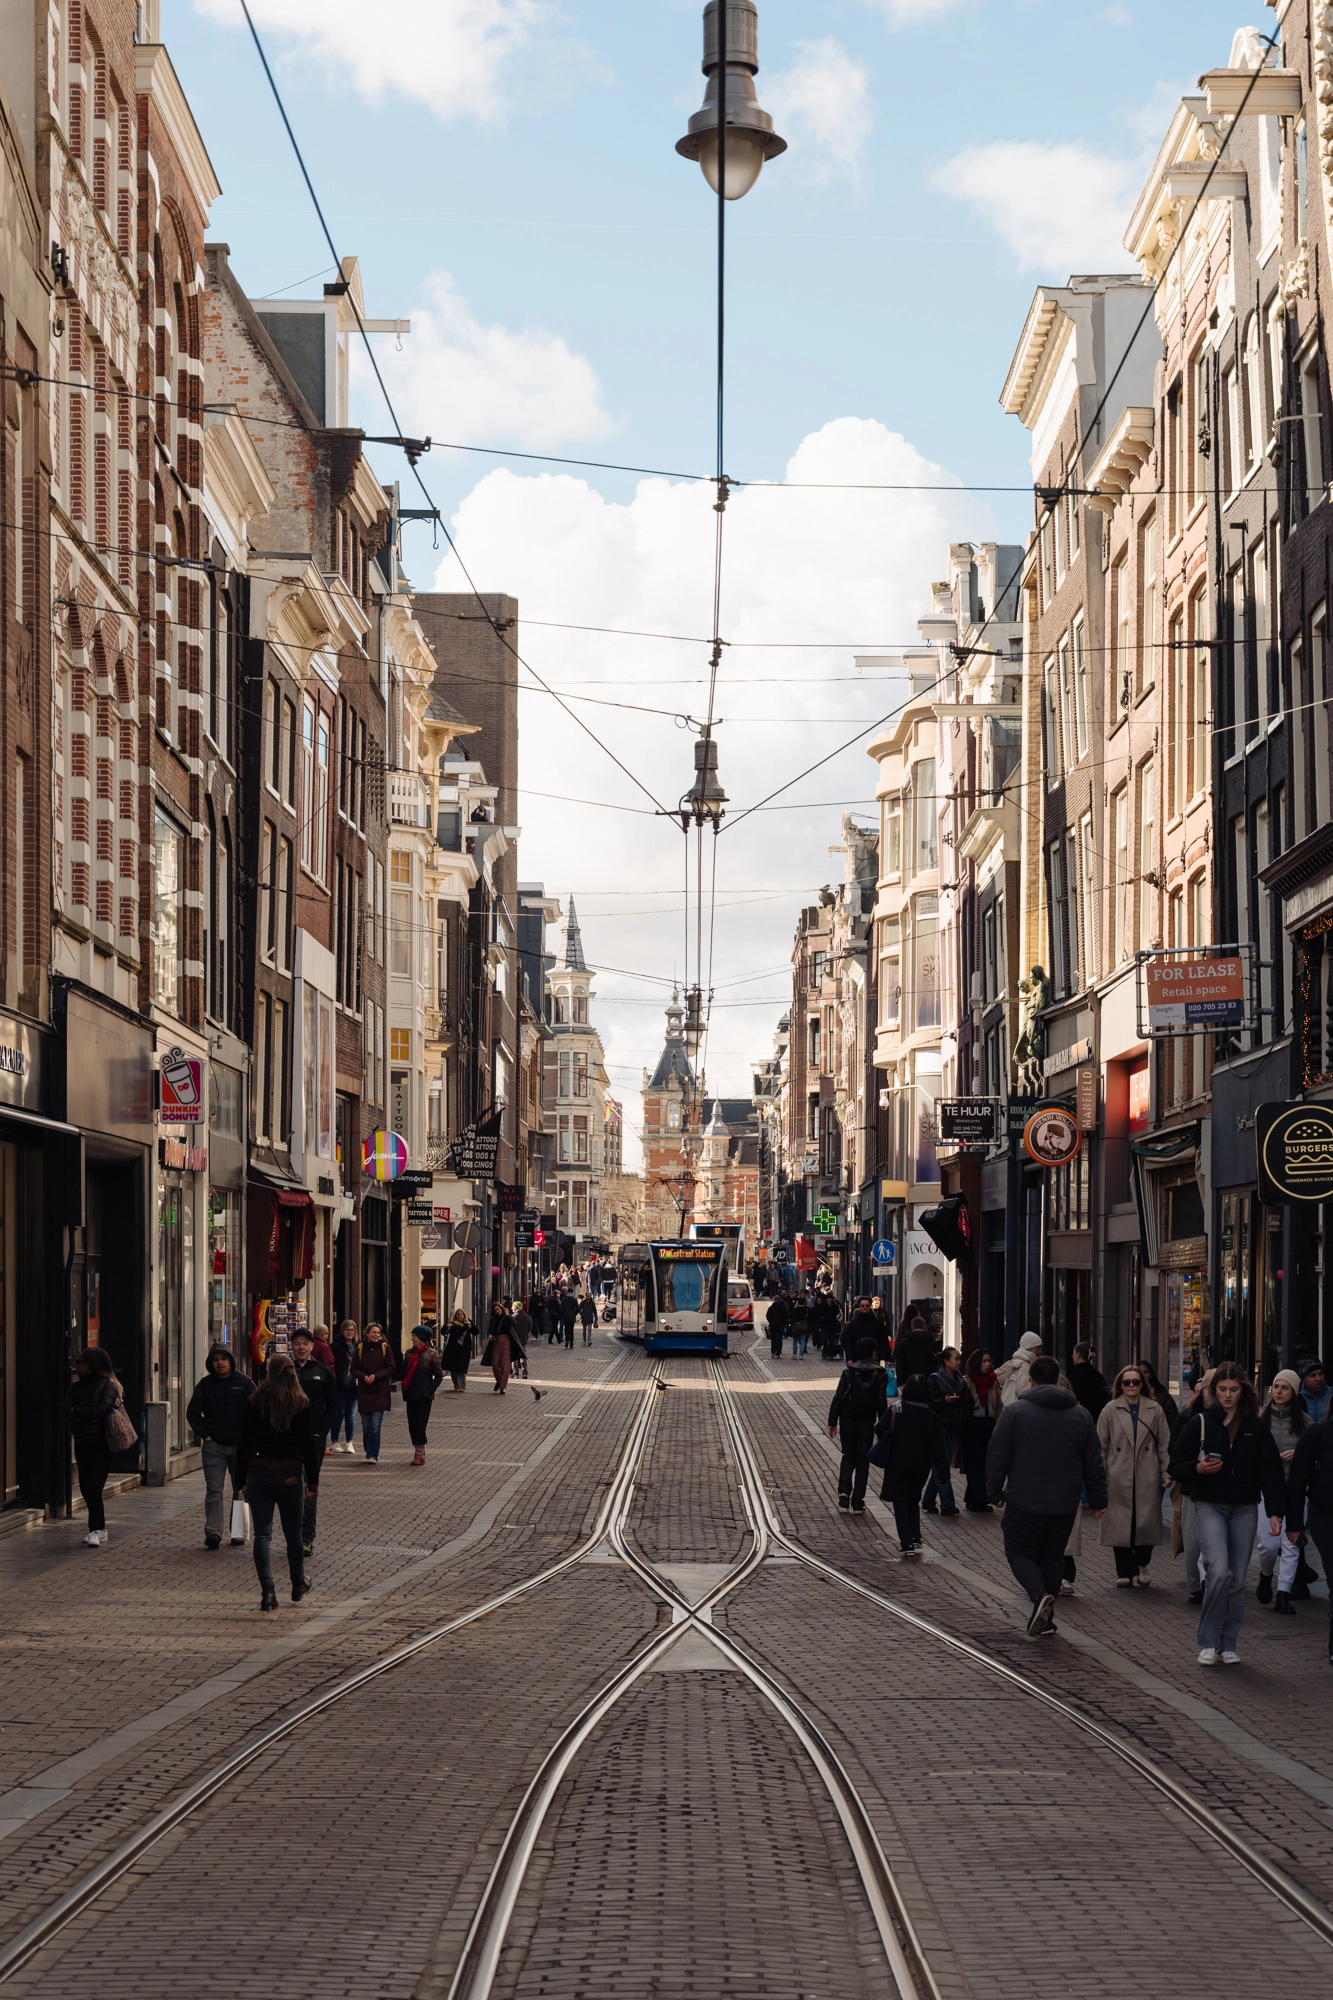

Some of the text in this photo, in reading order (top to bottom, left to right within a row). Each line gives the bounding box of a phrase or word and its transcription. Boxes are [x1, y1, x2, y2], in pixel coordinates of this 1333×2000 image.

[1153, 963, 1236, 981] FOR LEASE
[1162, 985, 1227, 997] Retail space
[1188, 1004, 1202, 1012] 020
[1227, 1001, 1237, 1009] 83
[1081, 1071, 1092, 1128] MANFIELD
[162, 1105, 202, 1113] DUNKIN'
[945, 1106, 958, 1116] TE
[960, 1106, 991, 1116] HUUR
[162, 1113, 199, 1121] DONUTS
[1035, 1114, 1076, 1131] HENRI WILLIG
[1285, 1144, 1333, 1154] BURGERS
[364, 1150, 404, 1164] jamin
[908, 1241, 941, 1254] ANCÔ
[671, 1249, 694, 1258] Centraal
[695, 1249, 715, 1258] Station
